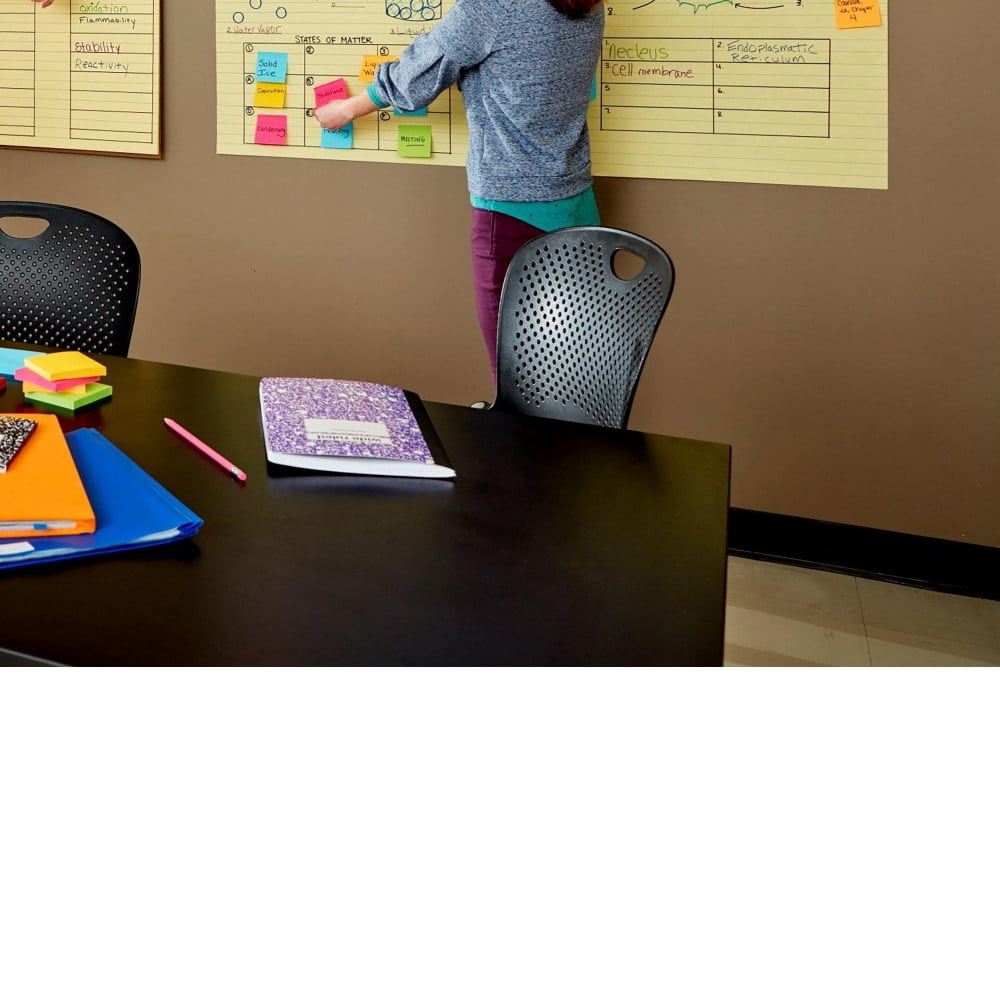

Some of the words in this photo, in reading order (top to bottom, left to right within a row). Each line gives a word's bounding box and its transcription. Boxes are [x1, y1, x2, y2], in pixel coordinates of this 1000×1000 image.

[79, 17, 136, 29] Flammability
[295, 35, 321, 43] STATES
[75, 42, 120, 53] Stability
[75, 58, 129, 77] Reactivity
[259, 60, 277, 68] Solid
[638, 67, 694, 78] membrane
